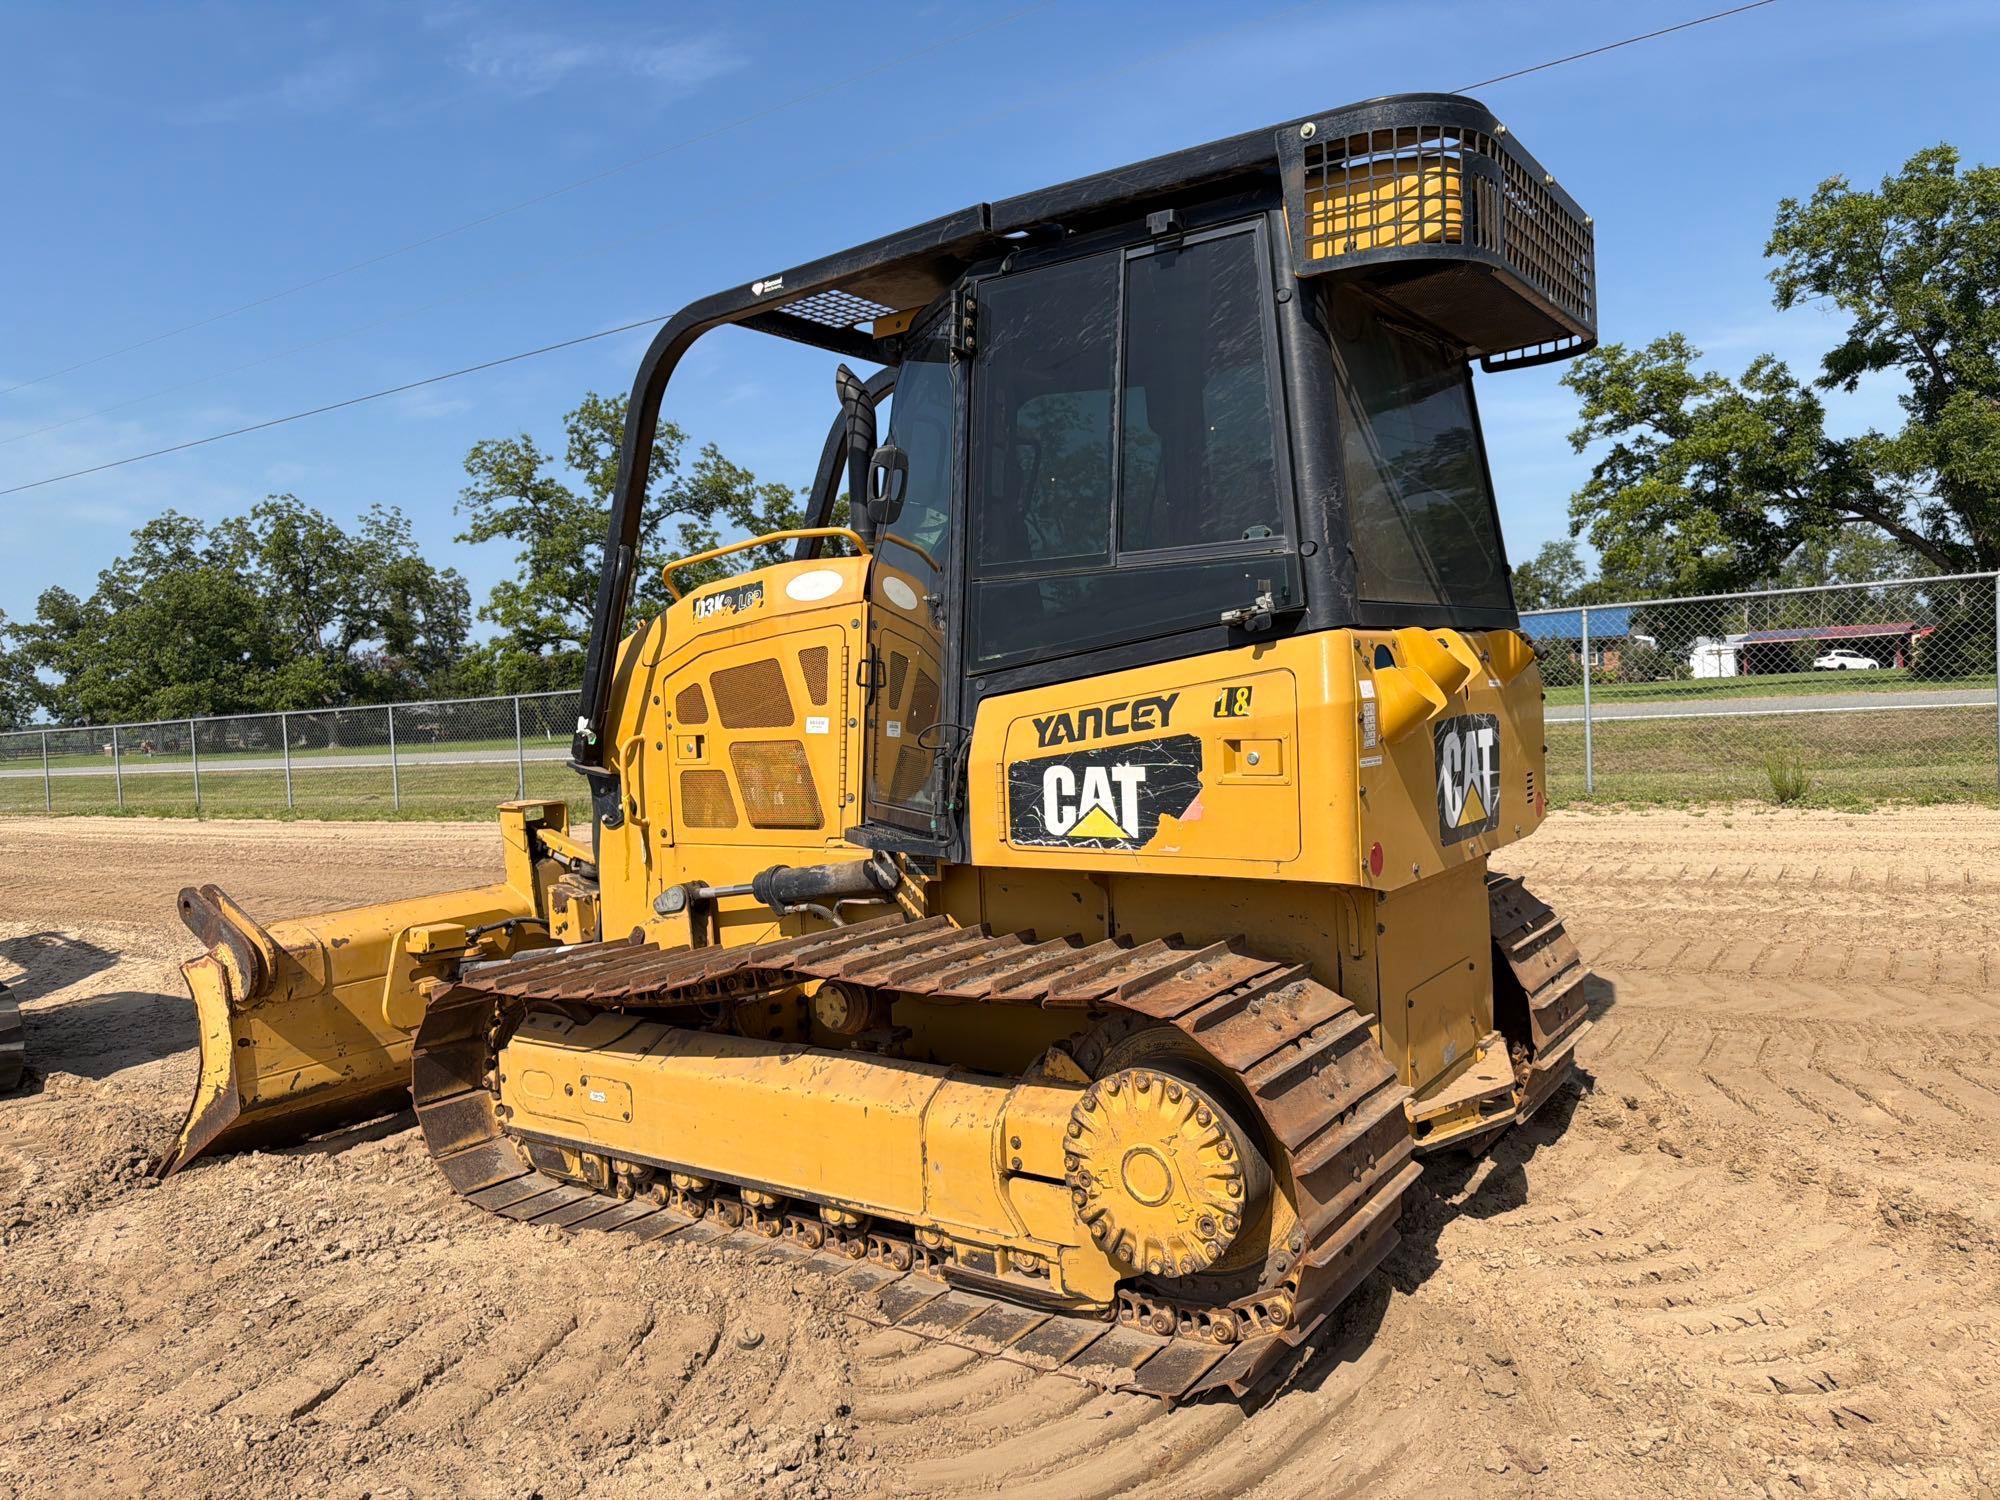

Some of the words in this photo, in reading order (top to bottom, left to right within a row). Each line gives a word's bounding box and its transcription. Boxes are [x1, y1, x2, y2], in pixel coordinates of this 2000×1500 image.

[1032, 692, 1180, 748] YANCEY
[1216, 686, 1249, 717] 18
[1043, 763, 1147, 839] CAT
[1442, 727, 1494, 829] CAT
